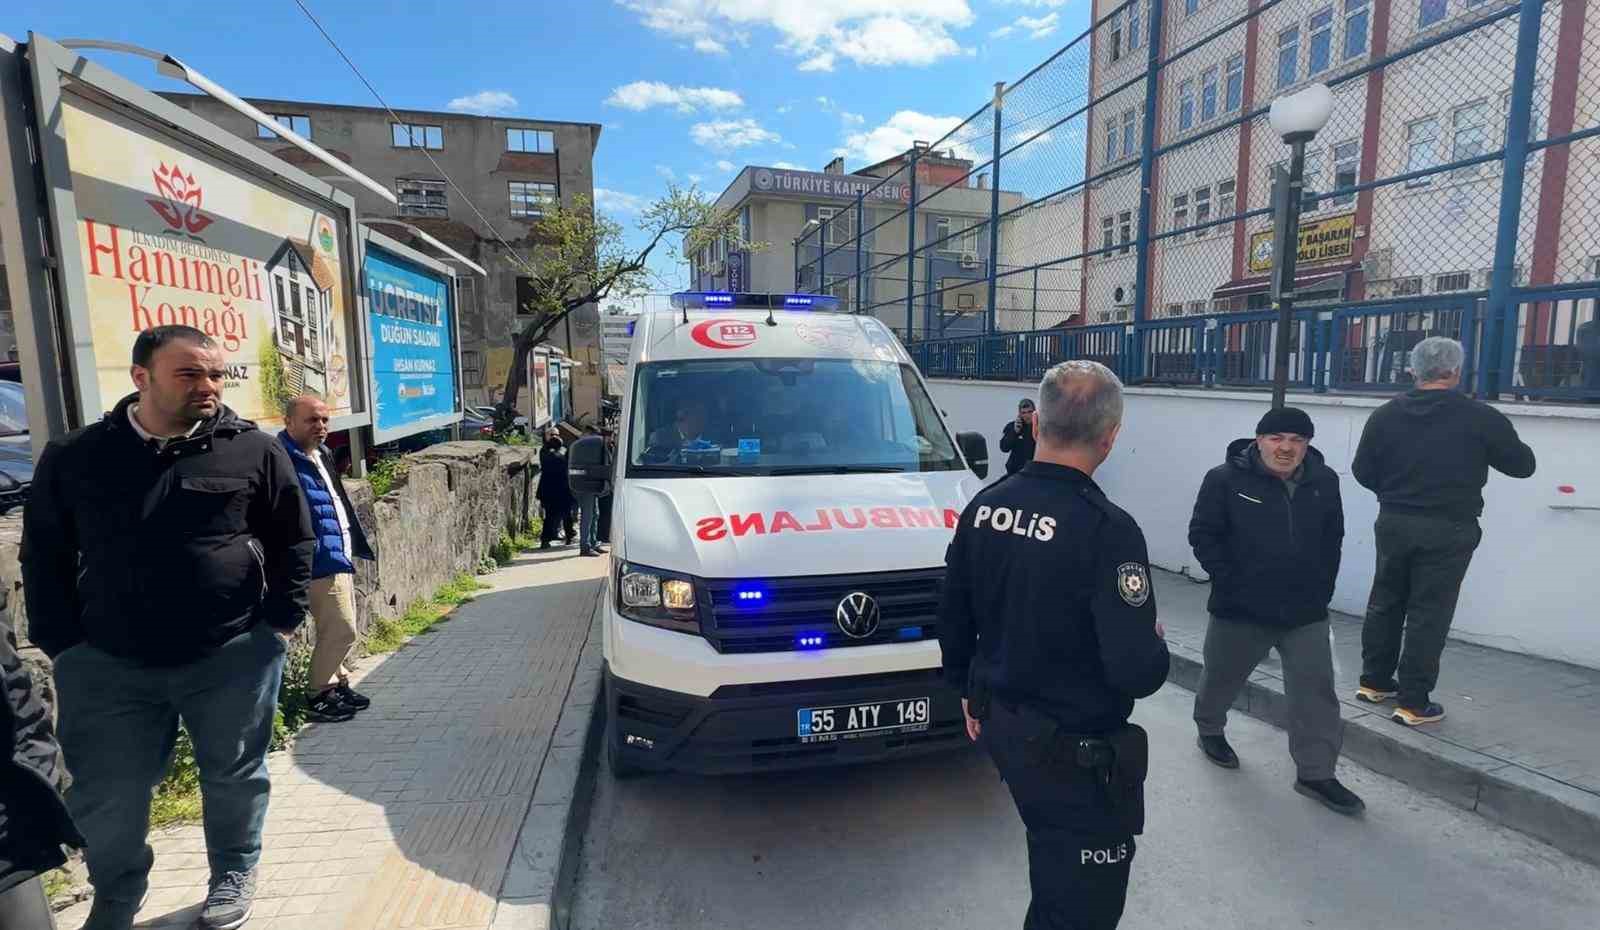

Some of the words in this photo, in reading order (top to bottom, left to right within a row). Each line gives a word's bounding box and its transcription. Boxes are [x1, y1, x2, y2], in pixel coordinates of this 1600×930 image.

[775, 172, 831, 193] TÜRKİYE
[84, 217, 264, 301] Hanımeli
[129, 284, 249, 352] Konağı
[725, 325, 752, 335] 112
[811, 709, 835, 732] 55
[847, 704, 881, 730] ATY
[896, 700, 927, 724] 149
